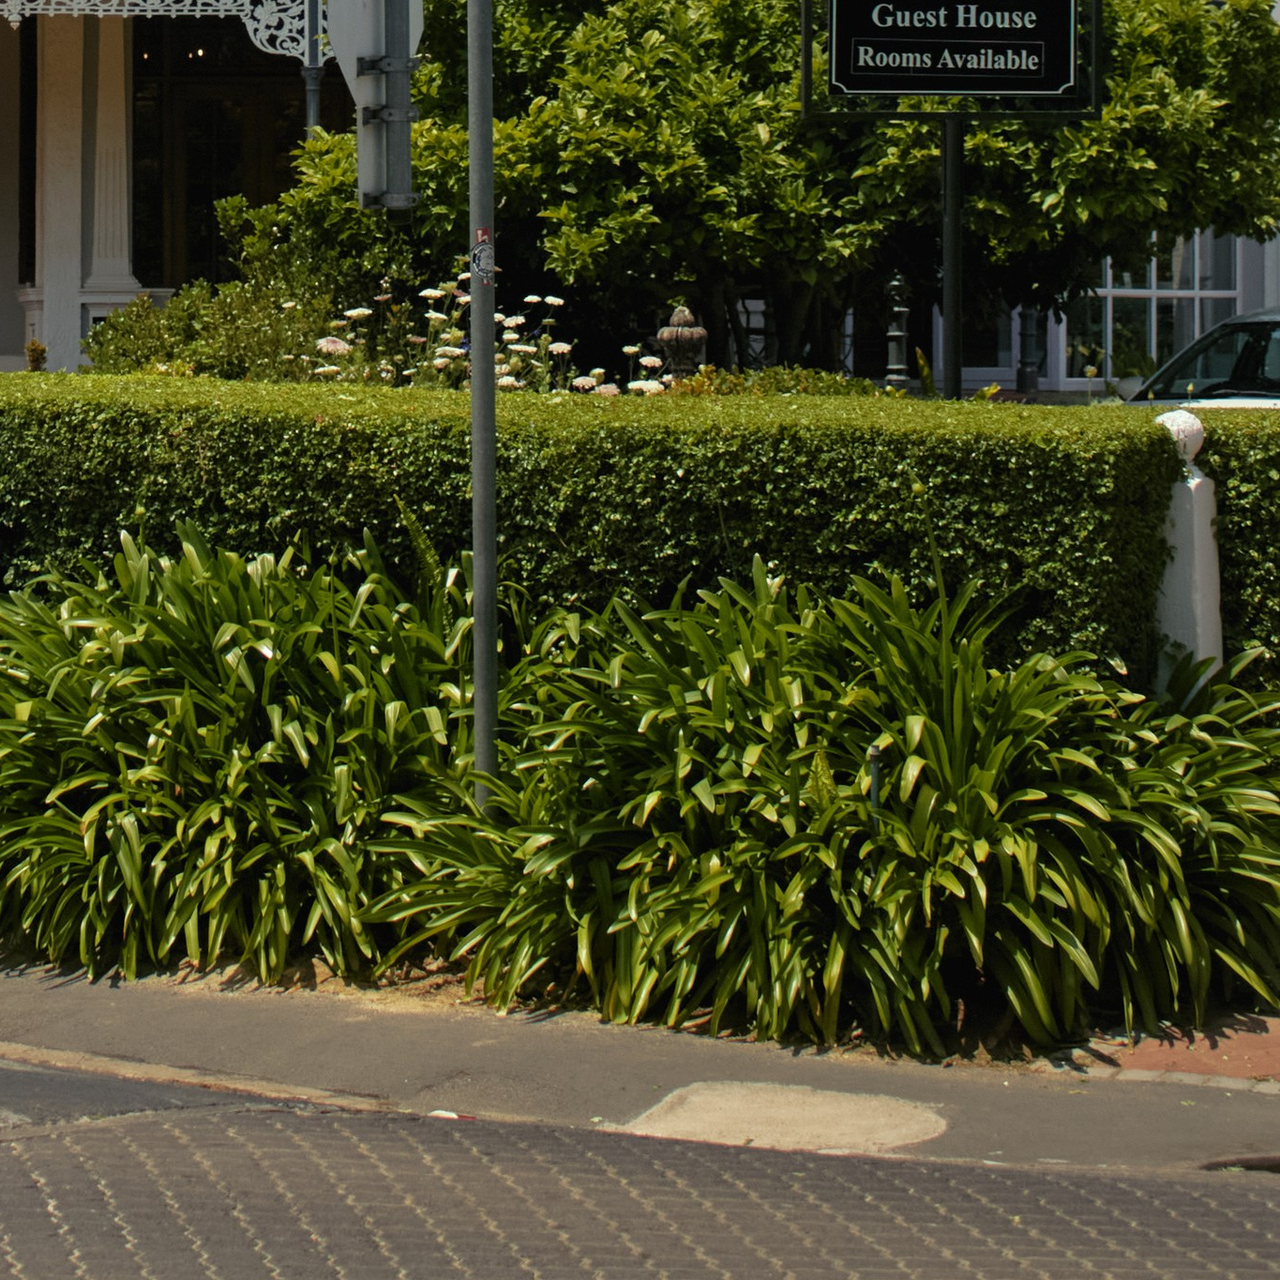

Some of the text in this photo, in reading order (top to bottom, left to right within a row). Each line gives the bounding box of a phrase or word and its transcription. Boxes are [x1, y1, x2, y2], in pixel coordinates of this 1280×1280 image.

[871, 3, 1037, 28] Guest House
[857, 46, 1039, 70] Rooms Available
